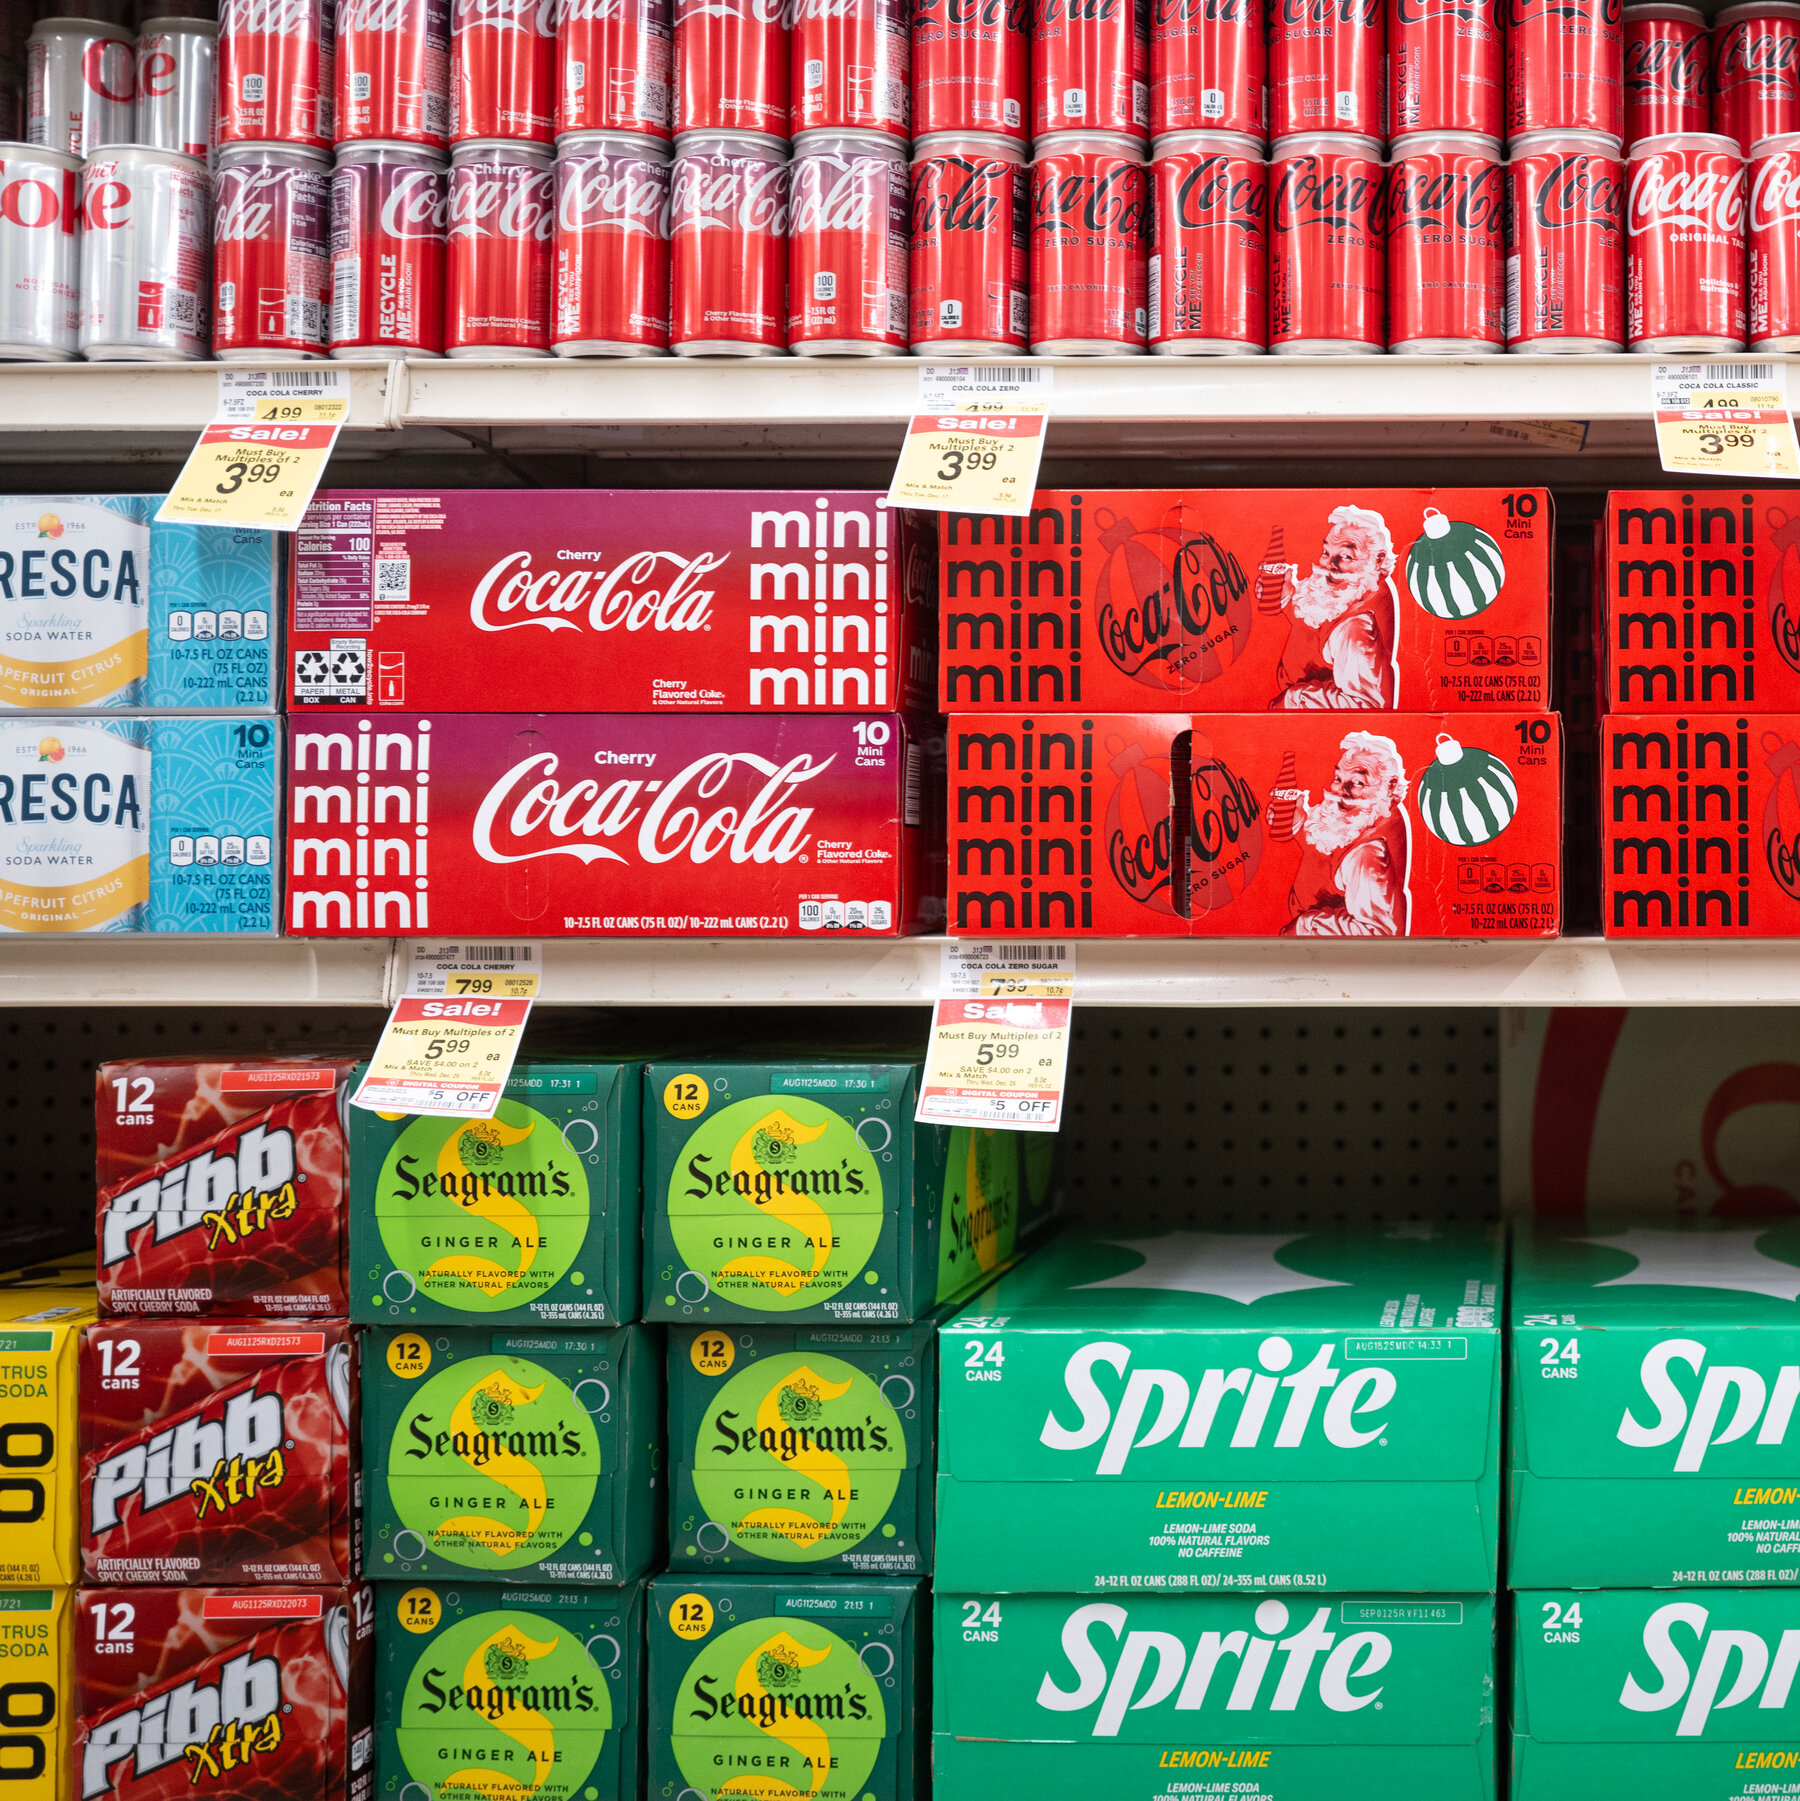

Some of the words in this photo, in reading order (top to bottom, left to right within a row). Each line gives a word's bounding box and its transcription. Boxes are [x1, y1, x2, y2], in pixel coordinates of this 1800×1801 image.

[473, 164, 525, 177] Cherry
[710, 155, 761, 172] Cherry
[1044, 237, 1082, 248] ZERO
[1087, 237, 1133, 251] SUGAR
[1414, 235, 1453, 245] ZERO
[1459, 235, 1499, 248] SUGAR
[1670, 233, 1728, 244] ORIGINAL
[817, 275, 832, 286] 100
[379, 254, 396, 338] RECYCLE
[1174, 246, 1187, 333] RECYCLE
[1534, 246, 1549, 333] RECYCLE
[1190, 300, 1201, 330] ME
[396, 311, 410, 339] ME
[1682, 411, 1761, 419] Sale!
[937, 418, 1016, 430] Sale!
[229, 427, 309, 441] Sale!
[215, 455, 273, 463] Multiples
[266, 449, 286, 457] Buy
[1502, 494, 1537, 517] 10
[752, 498, 888, 548] mini
[1506, 520, 1532, 528] Mini
[1618, 494, 1754, 544] mini
[1504, 529, 1534, 539] Cans
[298, 542, 332, 551] Calories
[349, 538, 370, 550] 100
[556, 550, 601, 563] Cherry
[750, 550, 888, 599] mini
[948, 548, 1082, 598] mini
[470, 550, 731, 632] Coca-Cola
[1100, 532, 1250, 676] Coca-Cola
[1167, 651, 1198, 674] ZERO
[1200, 625, 1239, 653] SUGAR
[234, 725, 269, 747] 10
[852, 721, 890, 745] 10
[295, 720, 432, 770] mini
[858, 746, 883, 756] Mini
[238, 750, 263, 758] Mini
[594, 750, 656, 768] Cherry
[854, 756, 885, 766] Cans
[236, 760, 265, 768] Cans
[0, 773, 141, 829] RESCA
[473, 752, 838, 866] Coca-Cola
[17, 836, 82, 855] Sparkling
[6, 856, 44, 865] SODA
[47, 856, 93, 865] WATER
[172, 874, 200, 885] 10-7.5
[204, 874, 217, 885] FL
[221, 874, 237, 885] OZ
[239, 874, 270, 885] CANS
[72, 878, 123, 907] CITRUS
[21, 912, 79, 921] ORIGINAL
[564, 917, 591, 928] 10-7.5
[592, 917, 601, 928] FL
[604, 917, 614, 928] OZ
[617, 917, 639, 928] CANS
[421, 1002, 502, 1017] Sale!
[392, 1027, 418, 1036] Must
[422, 1028, 441, 1037] Buy
[444, 1028, 492, 1038] Multiples
[968, 1032, 987, 1041] Buy
[991, 1032, 1038, 1041] Multiples
[486, 1053, 500, 1061] ea
[845, 1079, 867, 1088] 17:30
[112, 1077, 155, 1113] 12
[457, 1092, 490, 1102] OFF
[675, 1084, 698, 1100] 12
[672, 1103, 701, 1111] CANS
[1019, 1101, 1051, 1112] OFF
[116, 1113, 154, 1125] cans
[392, 1155, 570, 1207] Seagram's
[685, 1154, 864, 1205] Seagram's
[103, 1122, 297, 1269] Pibb
[203, 1182, 297, 1250] Xtra
[421, 1237, 498, 1248] GINGER
[512, 1237, 548, 1248] ALE
[713, 1237, 791, 1248] GINGER
[805, 1237, 841, 1248] ALE
[113, 1302, 138, 1312] SPICY
[140, 1302, 174, 1312] CHERRY
[176, 1302, 199, 1312] SODA
[964, 1340, 1005, 1368] 24
[1540, 1338, 1581, 1364] 24
[966, 1369, 1002, 1382] CANS
[1542, 1368, 1577, 1378] CANS
[1040, 1336, 1397, 1475] Sprite
[405, 1414, 581, 1466] Seagram's
[712, 1410, 888, 1461] Seagram's
[1155, 1491, 1269, 1508] LEMON-LIME
[1163, 1523, 1227, 1534] LEMON-LIME
[1229, 1523, 1256, 1534] SODA
[1149, 1536, 1176, 1546] 100%
[1178, 1536, 1223, 1546] NATURAL
[1225, 1536, 1270, 1546] FLAVORS
[1178, 1548, 1193, 1558] NO
[1195, 1548, 1243, 1558] CAFFEINE
[90, 1602, 135, 1640] 12
[1036, 1599, 1393, 1737] Sprite
[82, 1652, 282, 1799] Pibb
[1159, 1751, 1271, 1768] LEMON-LIME
